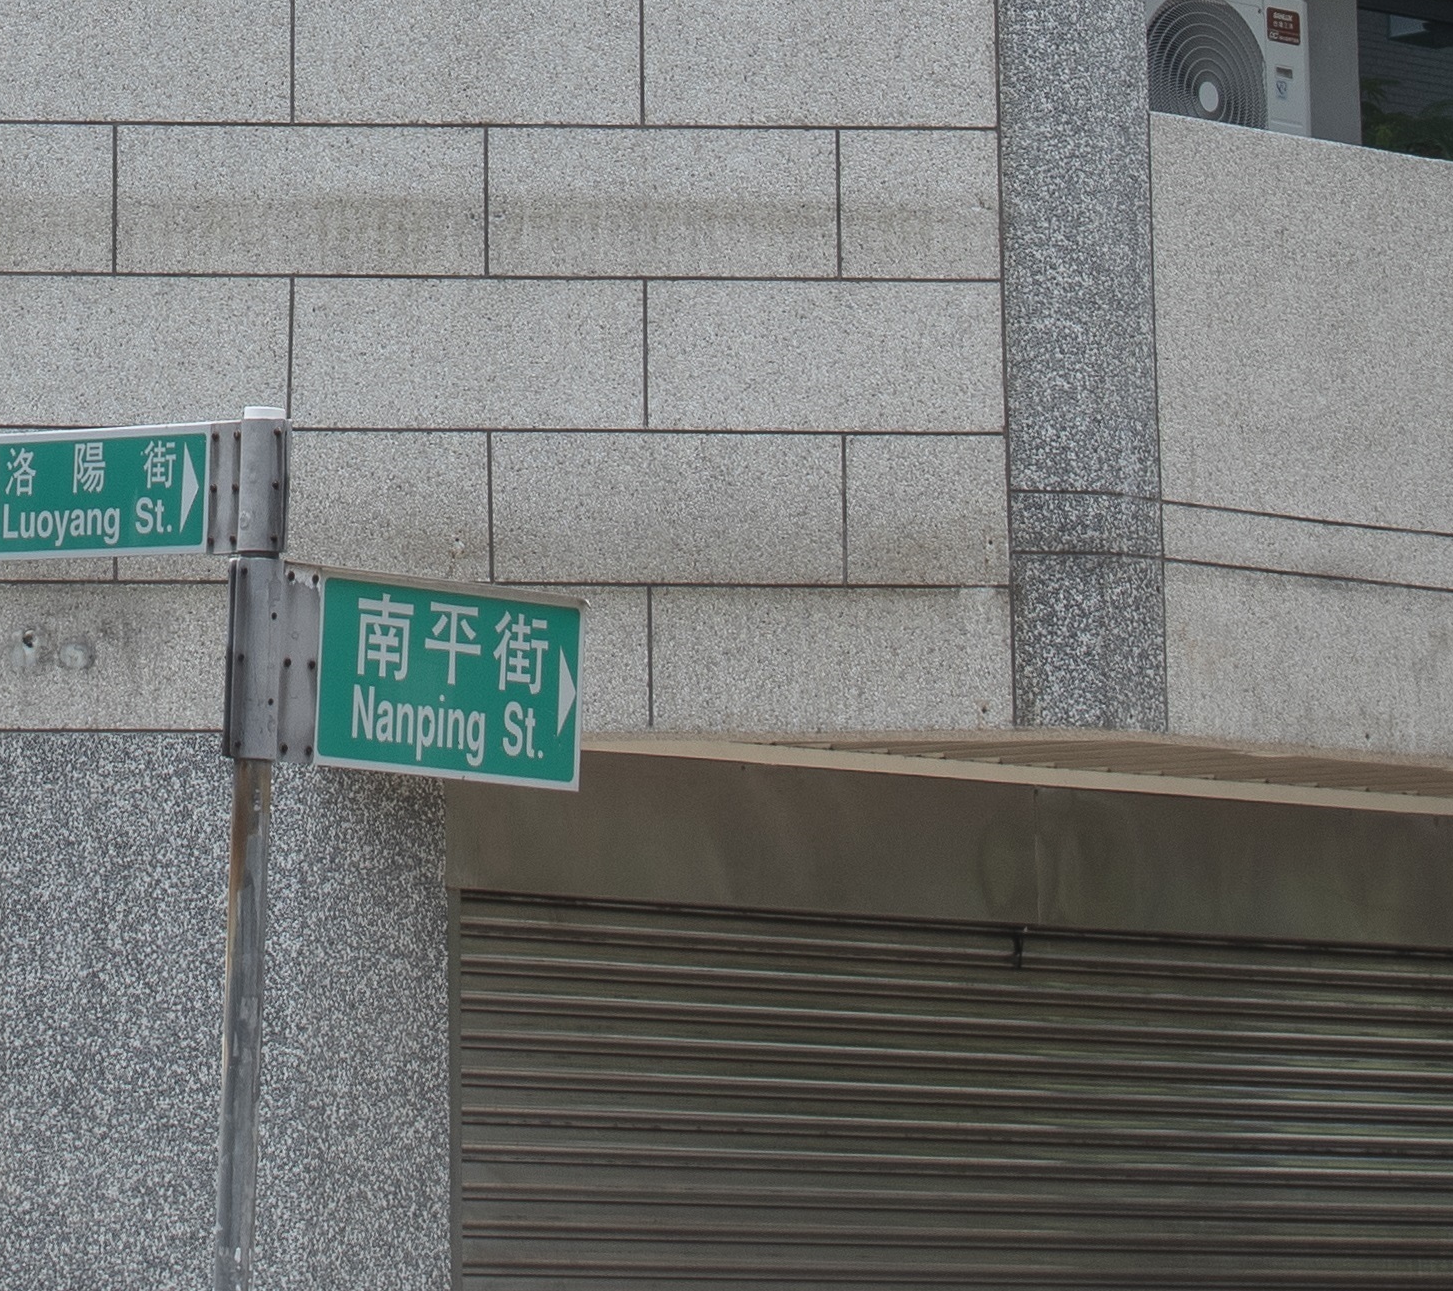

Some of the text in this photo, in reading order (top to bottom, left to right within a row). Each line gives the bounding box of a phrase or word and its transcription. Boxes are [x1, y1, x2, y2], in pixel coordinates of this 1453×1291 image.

[6, 440, 178, 496] 洛陽街
[2, 497, 173, 546] Luoyang St.
[356, 593, 548, 696] 南平街
[351, 683, 543, 765] Nanping St.
